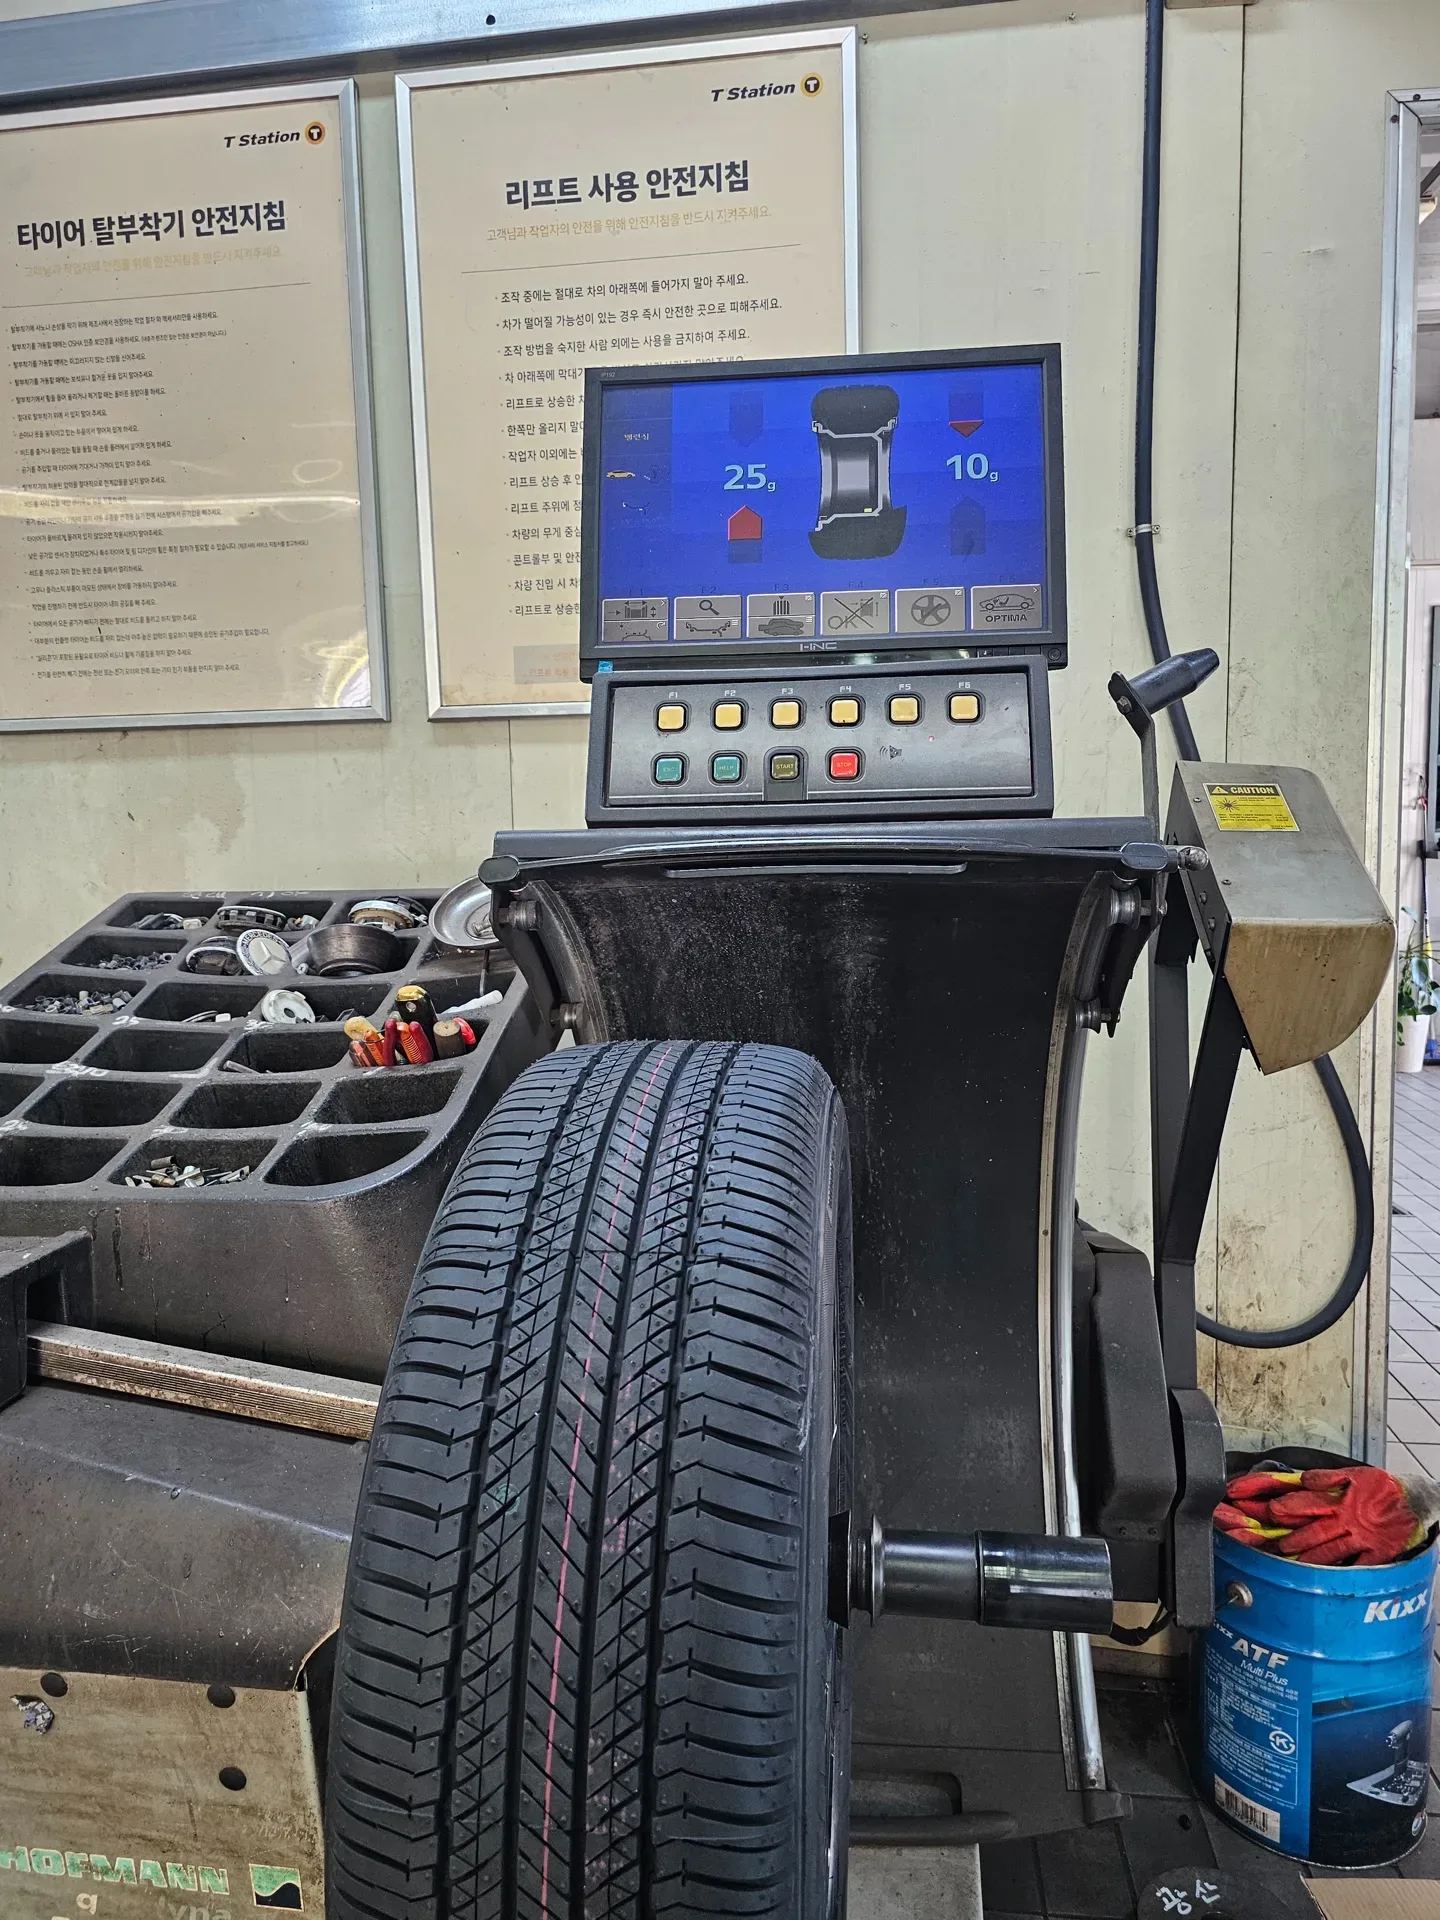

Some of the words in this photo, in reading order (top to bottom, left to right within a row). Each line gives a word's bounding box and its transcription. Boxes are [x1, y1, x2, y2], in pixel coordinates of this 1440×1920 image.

[712, 89, 724, 102] T
[726, 82, 795, 101] Station
[224, 136, 236, 148] T
[239, 130, 300, 148] Station
[506, 176, 582, 210] 리프트
[588, 170, 639, 204] 사용
[646, 160, 749, 200] 안전지침
[17, 218, 86, 250] 타이어
[93, 209, 186, 246] 탈부착기
[191, 200, 287, 236] 안전지침
[486, 224, 526, 242] 고객님과
[529, 221, 570, 238] 작업자의
[571, 218, 602, 235] 안전을
[605, 216, 626, 232] 위해
[628, 212, 679, 230] 안전지침을
[682, 209, 714, 226] 반드시
[716, 205, 772, 223] 지켜주세요.
[501, 290, 520, 304] 조작
[523, 288, 551, 302] 중에는
[555, 285, 583, 300] 절대로
[586, 284, 606, 297] 차의
[608, 280, 648, 296] 아래쪽에
[651, 277, 691, 292] 들어가지
[690, 275, 712, 289] 말아
[716, 272, 749, 287] 주세요.
[502, 317, 520, 331] 차가
[524, 315, 552, 329] 떨어질
[556, 312, 594, 327] 가능성이
[597, 310, 616, 324] 있는
[620, 308, 638, 322] 경우
[642, 307, 661, 320] 즉시
[664, 304, 693, 319] 안전한
[697, 302, 726, 316] 곳으로
[730, 298, 783, 314] 피해주세요.
[504, 344, 522, 357] 조작
[525, 341, 553, 356] 방법을
[557, 339, 585, 354] 숙지한
[590, 338, 607, 351] 사람
[610, 336, 639, 350] 외에는
[643, 333, 671, 348] 사용을
[675, 330, 714, 345] 금지하여
[717, 328, 750, 342] 주세요.
[505, 372, 514, 384] 차
[516, 368, 555, 383] 아래쪽에
[506, 396, 544, 410] 리프트로
[546, 394, 575, 408] 상승한
[507, 423, 535, 437] 한쪽만
[539, 421, 566, 435] 올리지
[508, 449, 536, 462] 작업자
[539, 447, 578, 461] 이외에는
[509, 476, 536, 489] 리프트
[541, 474, 558, 487] 상승
[562, 474, 571, 486] 후
[510, 501, 537, 513] 리프트
[542, 500, 570, 512] 주위에
[512, 527, 539, 539] 차량의
[543, 526, 561, 538] 무게
[513, 552, 549, 566] 콘트롤부
[552, 552, 562, 564] 및
[514, 579, 532, 592] 차량
[535, 578, 553, 590] 진입
[557, 577, 566, 589] 시
[514, 604, 551, 616] 리프트로
[985, 613, 1028, 623] OPTIMA
[1230, 786, 1274, 794] CAUTION
[1363, 1588, 1428, 1623] Kixx
[1231, 1638, 1289, 1669] ATF
[1240, 1659, 1264, 1677] Multi
[1265, 1670, 1289, 1686] Plus
